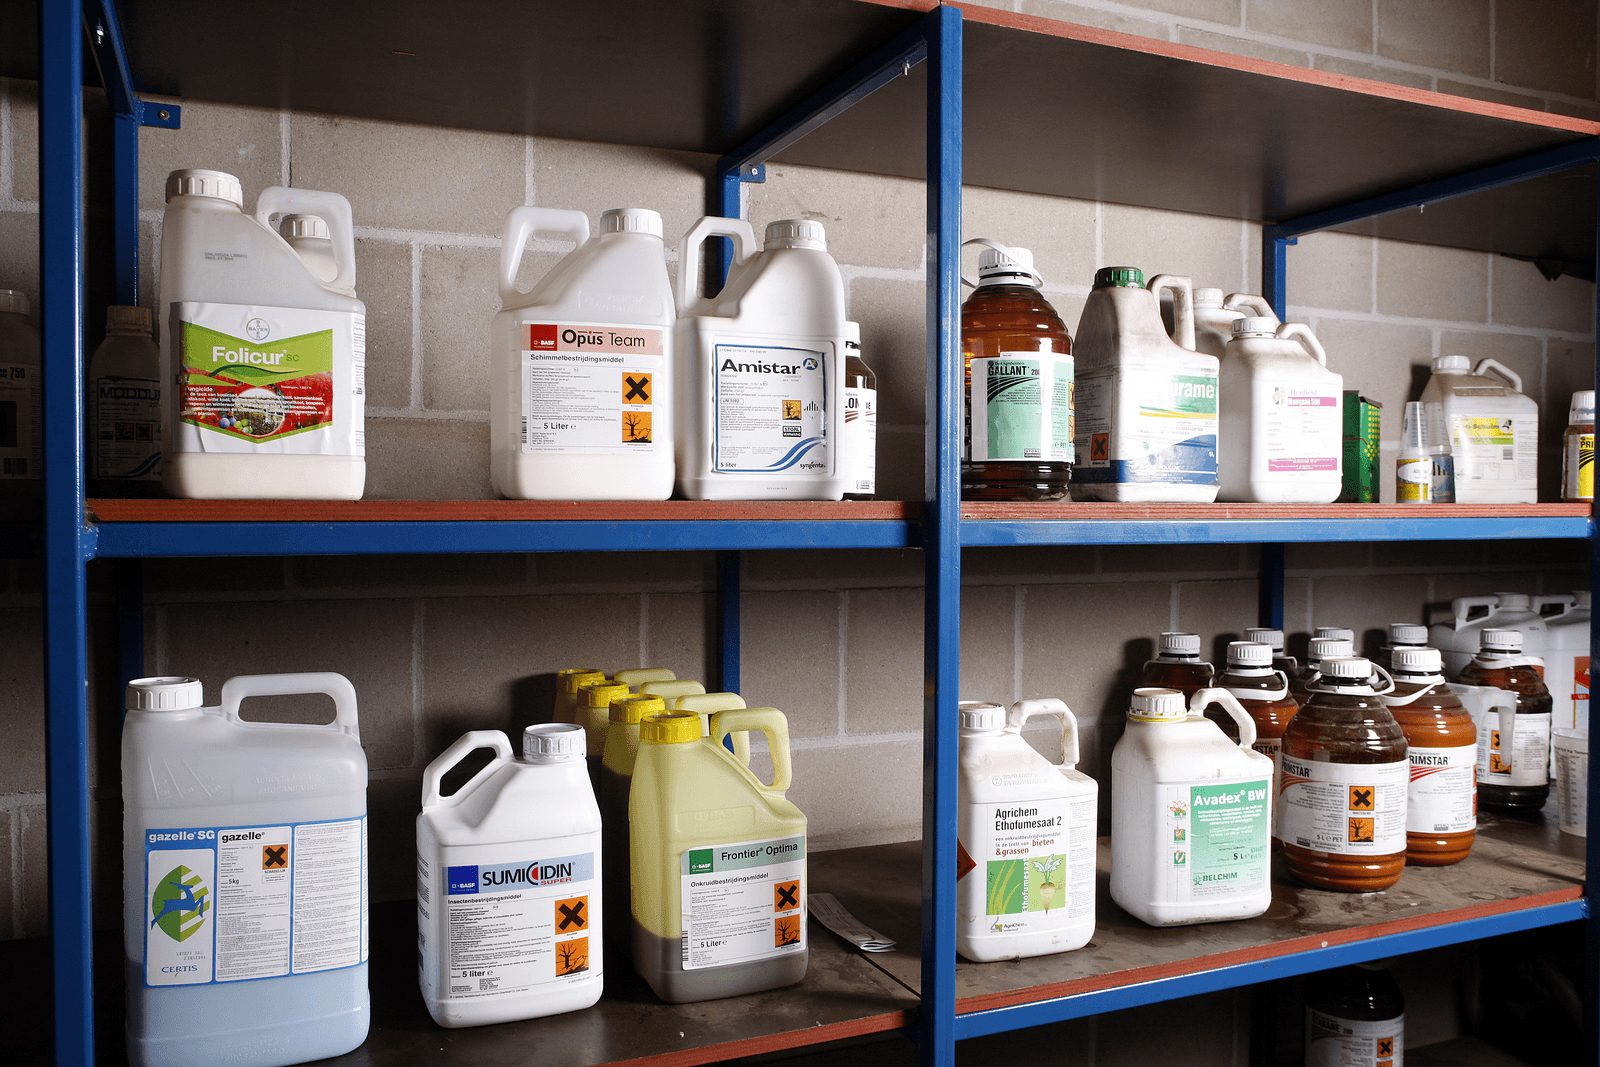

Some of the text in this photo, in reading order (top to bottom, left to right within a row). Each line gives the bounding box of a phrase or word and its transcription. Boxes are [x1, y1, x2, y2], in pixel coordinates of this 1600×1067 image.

[608, 332, 645, 347] Team
[530, 353, 625, 364] Schimmelbestrijdingsmiddel
[720, 358, 801, 375] Amistar
[988, 366, 1027, 376] GALLANT
[9, 367, 25, 379] 750
[543, 422, 569, 430] 5 Liter
[1248, 788, 1266, 801] BW
[995, 807, 1038, 820] Agrichem
[995, 816, 1062, 831] Ethofumesaat 2
[197, 830, 216, 840] SG
[1032, 838, 1055, 847] bieten
[765, 843, 798, 857] Optima
[1001, 847, 1029, 858] grassen
[1233, 852, 1238, 860] 5
[482, 861, 572, 887] SUMICIDIN
[1203, 872, 1238, 882] BELCHIM
[540, 877, 572, 886] SUPER
[690, 872, 769, 888] Onkruidbestrijdingsmiddel
[447, 893, 522, 905] Insectenbestrijdingsmiddel
[706, 940, 722, 948] Liter
[162, 965, 198, 975] CERTIS
[462, 970, 467, 978] 5
